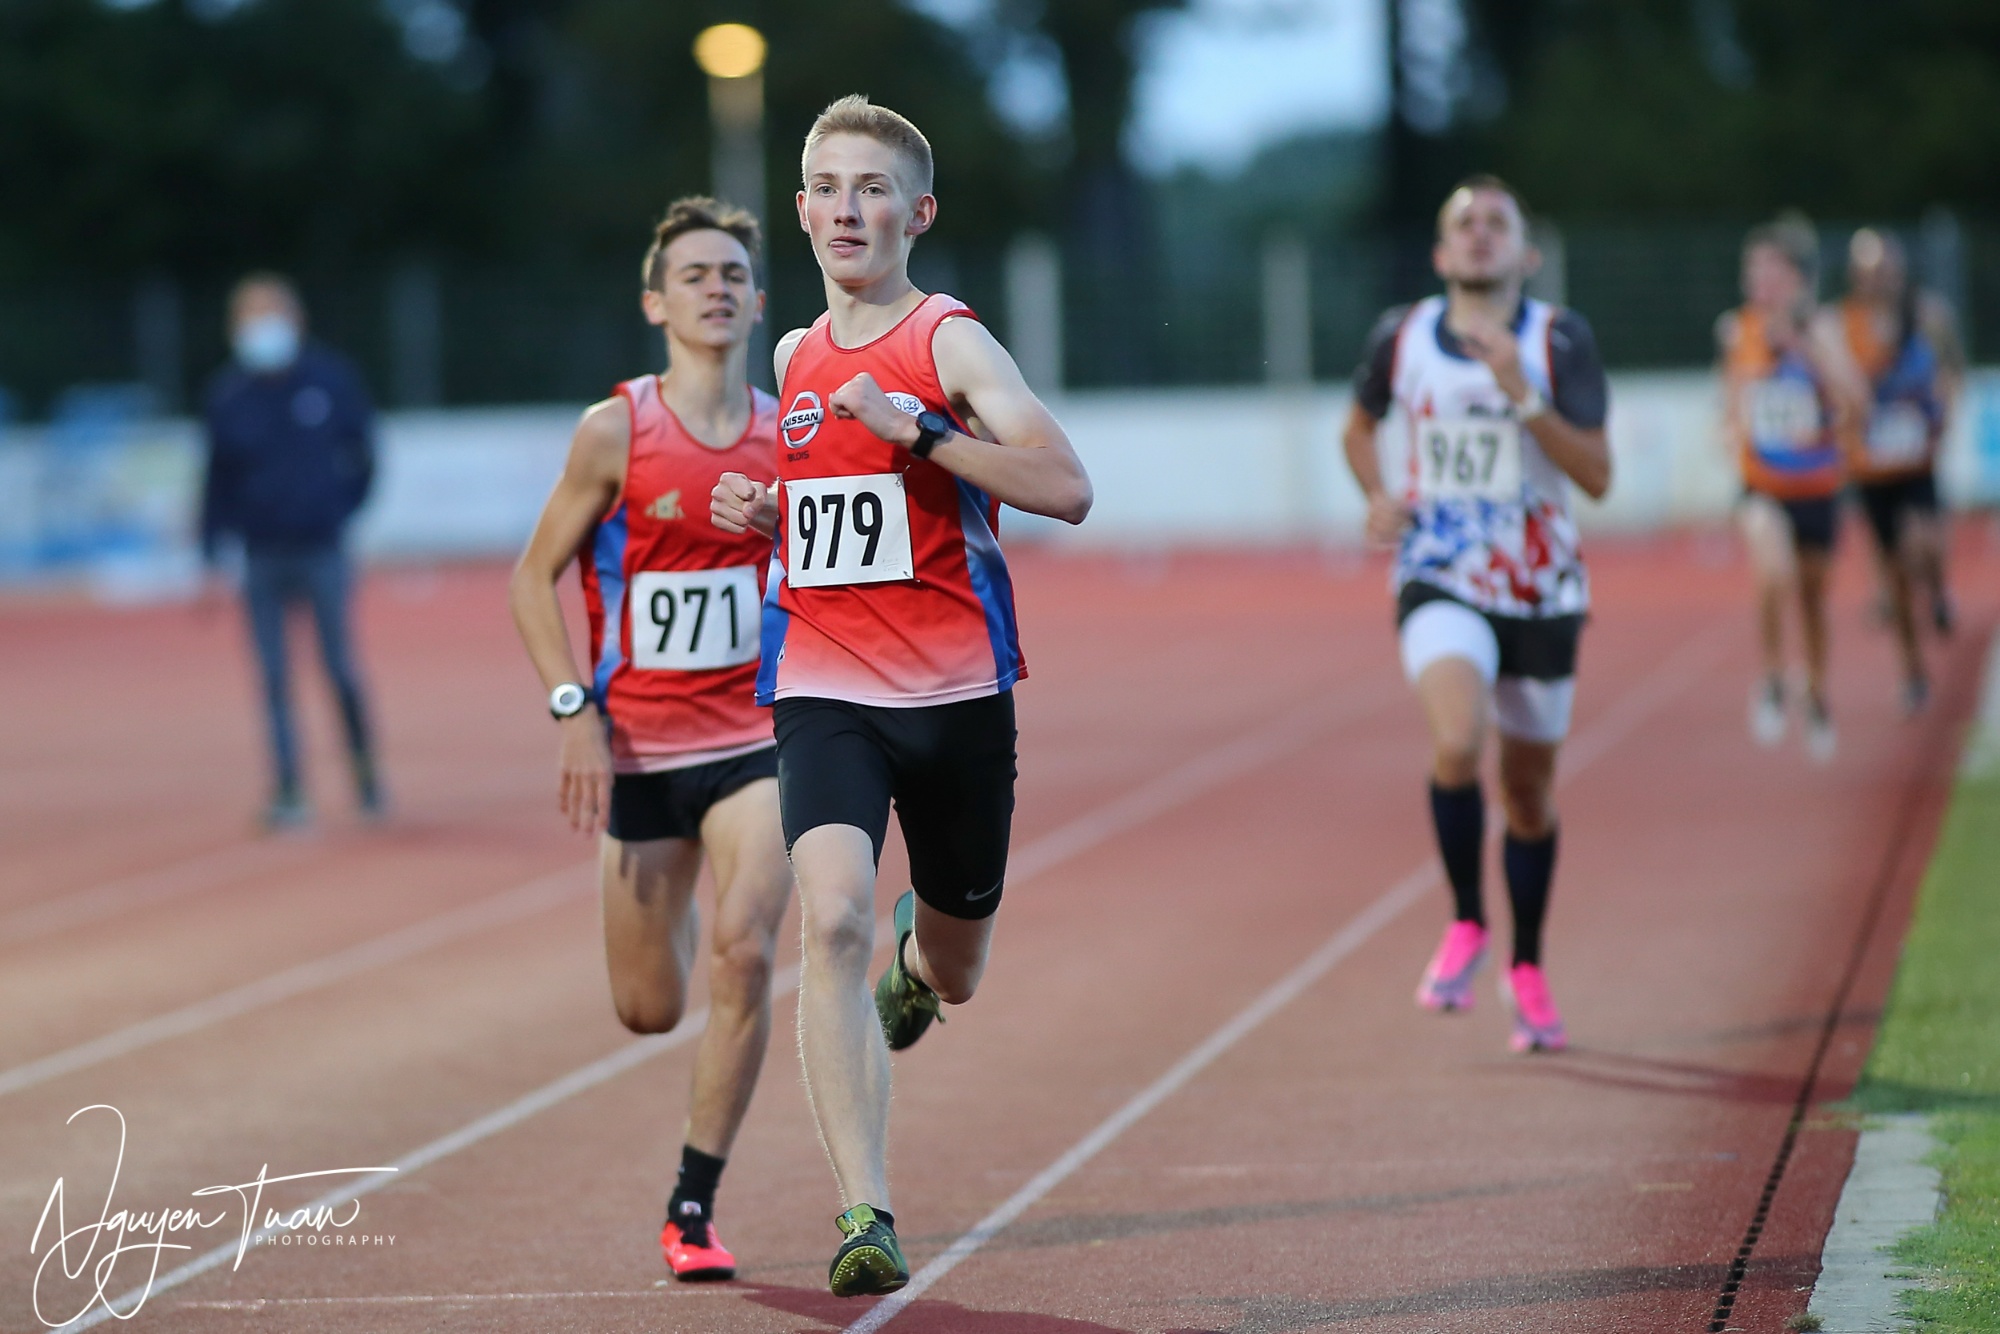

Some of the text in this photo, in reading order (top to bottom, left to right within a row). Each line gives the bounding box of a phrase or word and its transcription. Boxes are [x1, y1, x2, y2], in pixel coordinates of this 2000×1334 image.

[783, 411, 819, 427] NISSAN
[1428, 431, 1500, 485] 967
[798, 491, 884, 571] 979
[651, 583, 739, 653] 971
